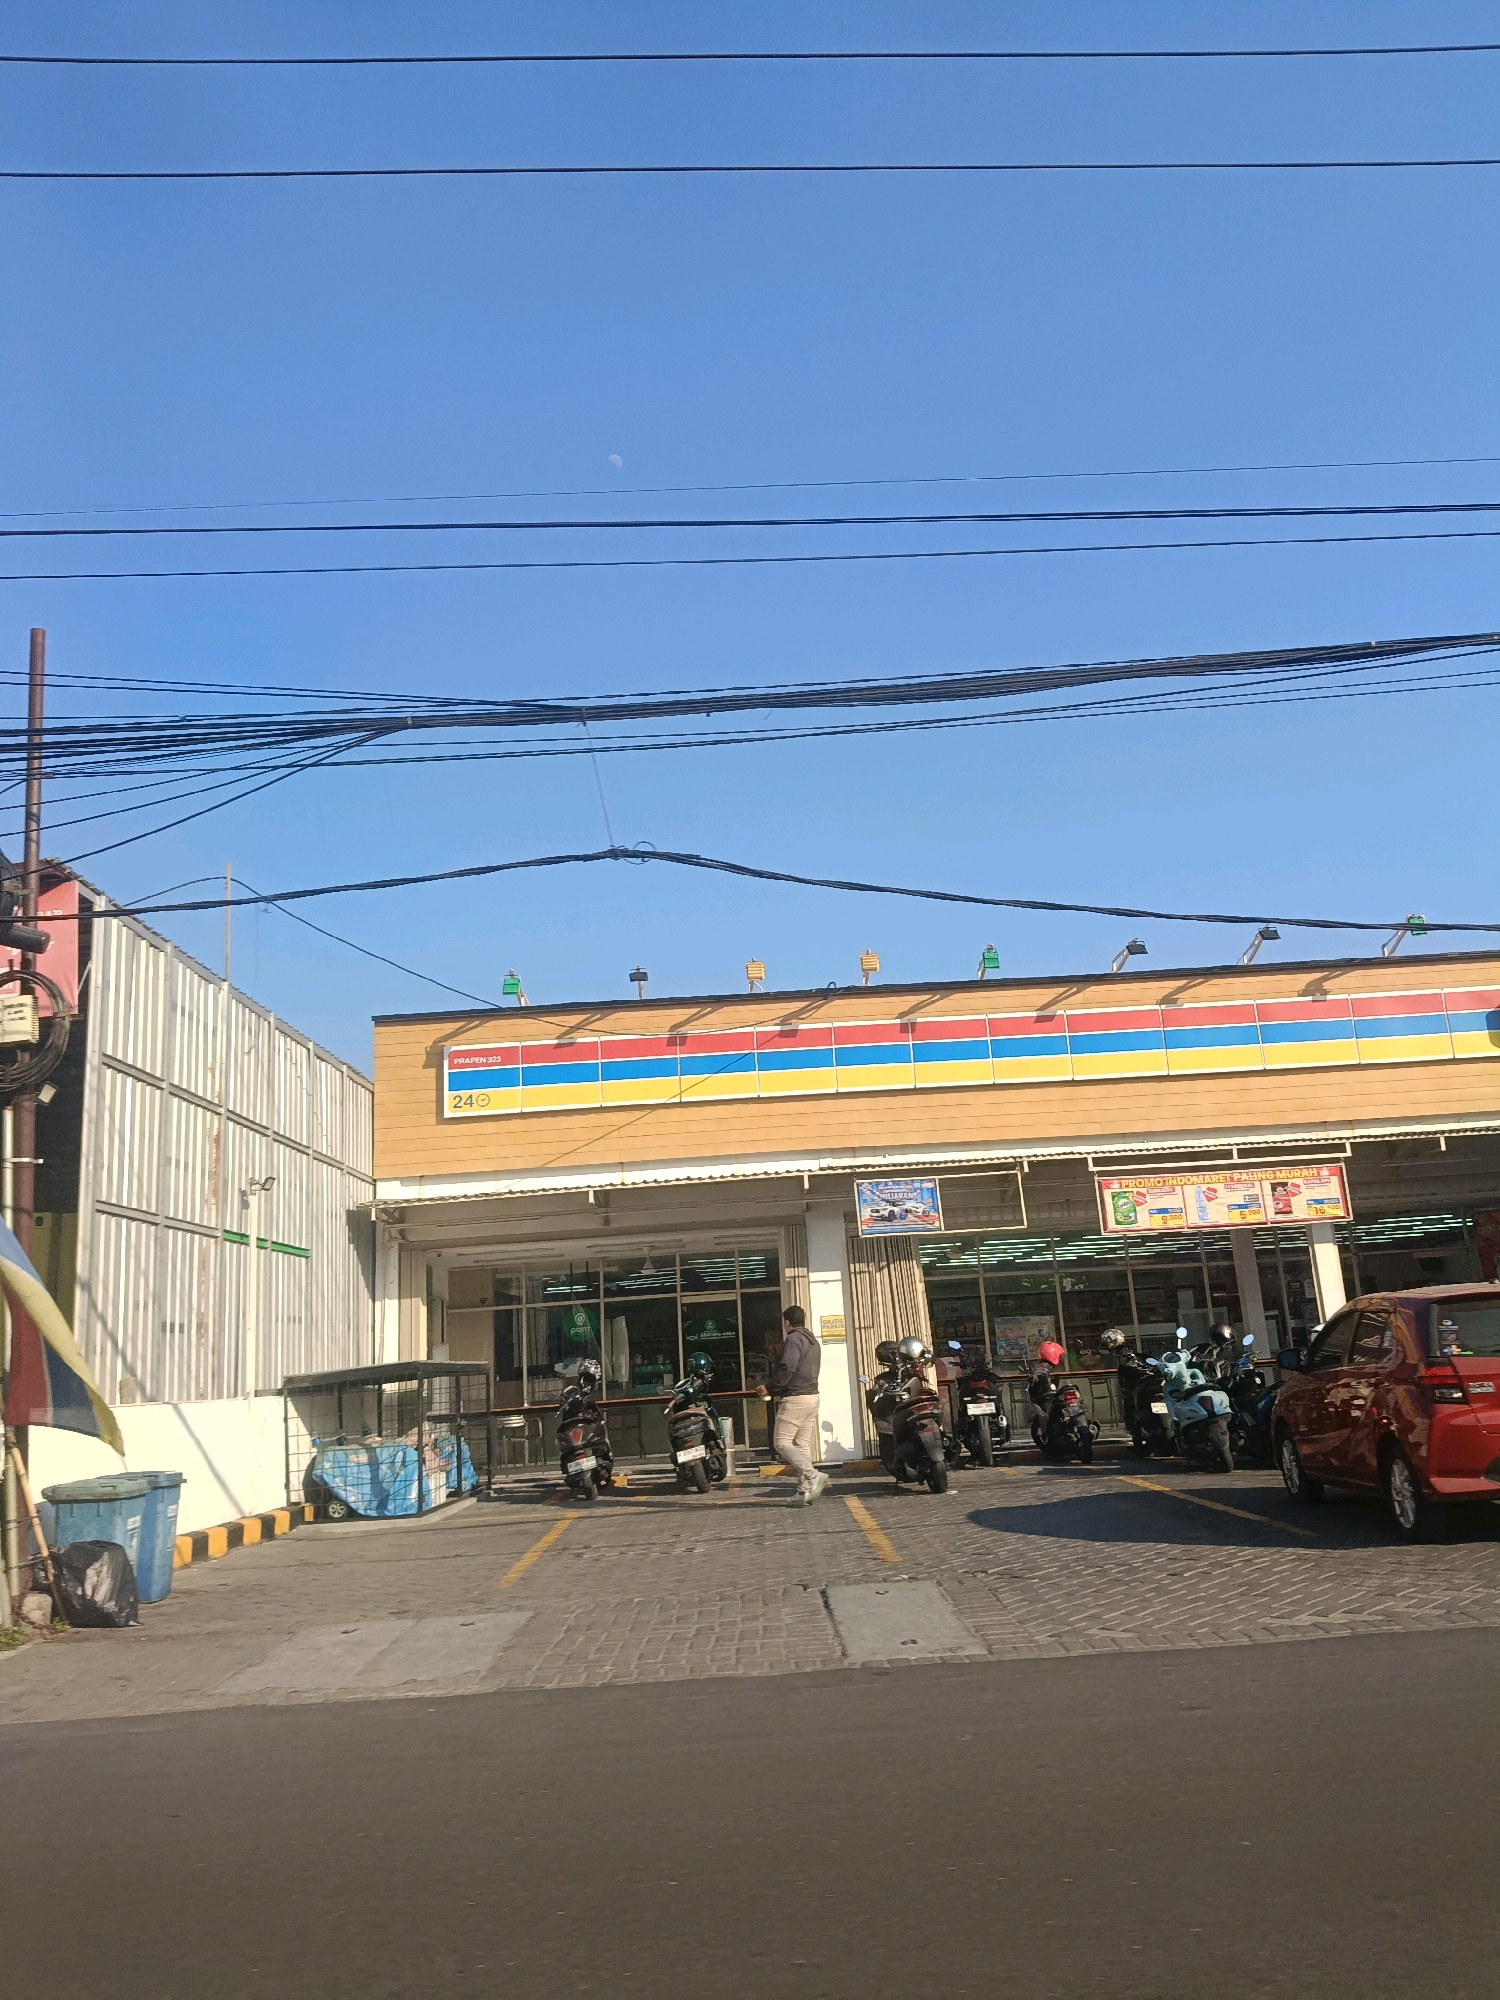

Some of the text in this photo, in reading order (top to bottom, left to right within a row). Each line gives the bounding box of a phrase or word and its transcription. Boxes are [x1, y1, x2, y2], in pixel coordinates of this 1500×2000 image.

[453, 1056, 486, 1064] PRAPEN
[453, 1094, 475, 1109] 24
[1121, 1167, 1318, 1188] PROMO INDOMARET PALING MURAH
